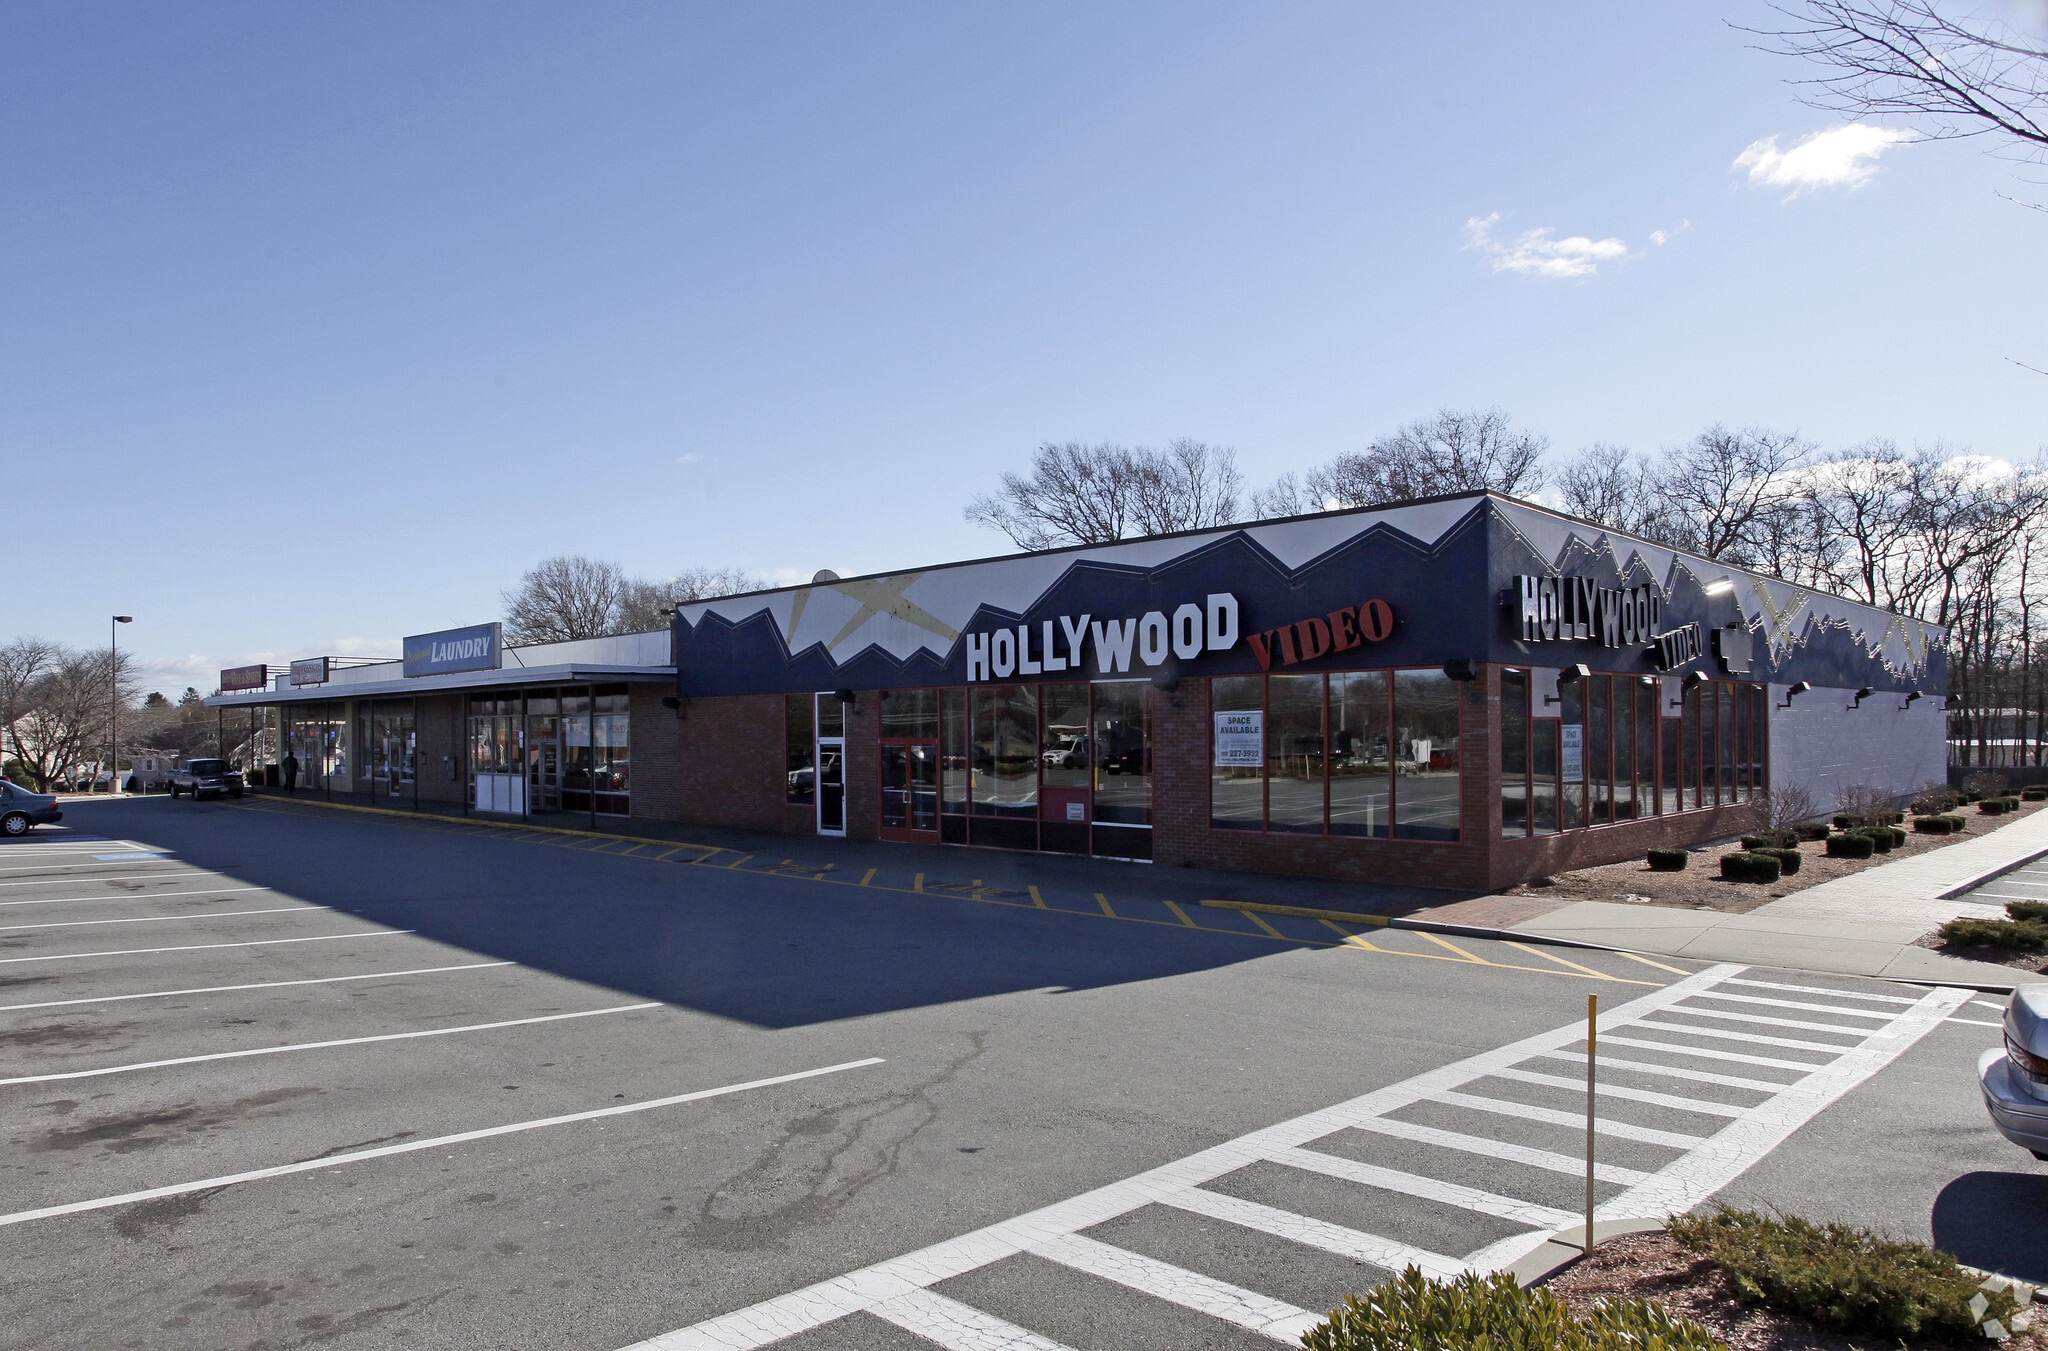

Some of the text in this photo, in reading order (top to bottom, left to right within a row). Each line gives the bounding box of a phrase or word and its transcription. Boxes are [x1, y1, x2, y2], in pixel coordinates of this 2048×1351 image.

[967, 593, 1394, 681] HOLLYWOOD VIDEO
[1521, 575, 1662, 648] HOLLYWOOD
[430, 636, 491, 663] LAUNDRY
[1660, 621, 1703, 672] VIDEO
